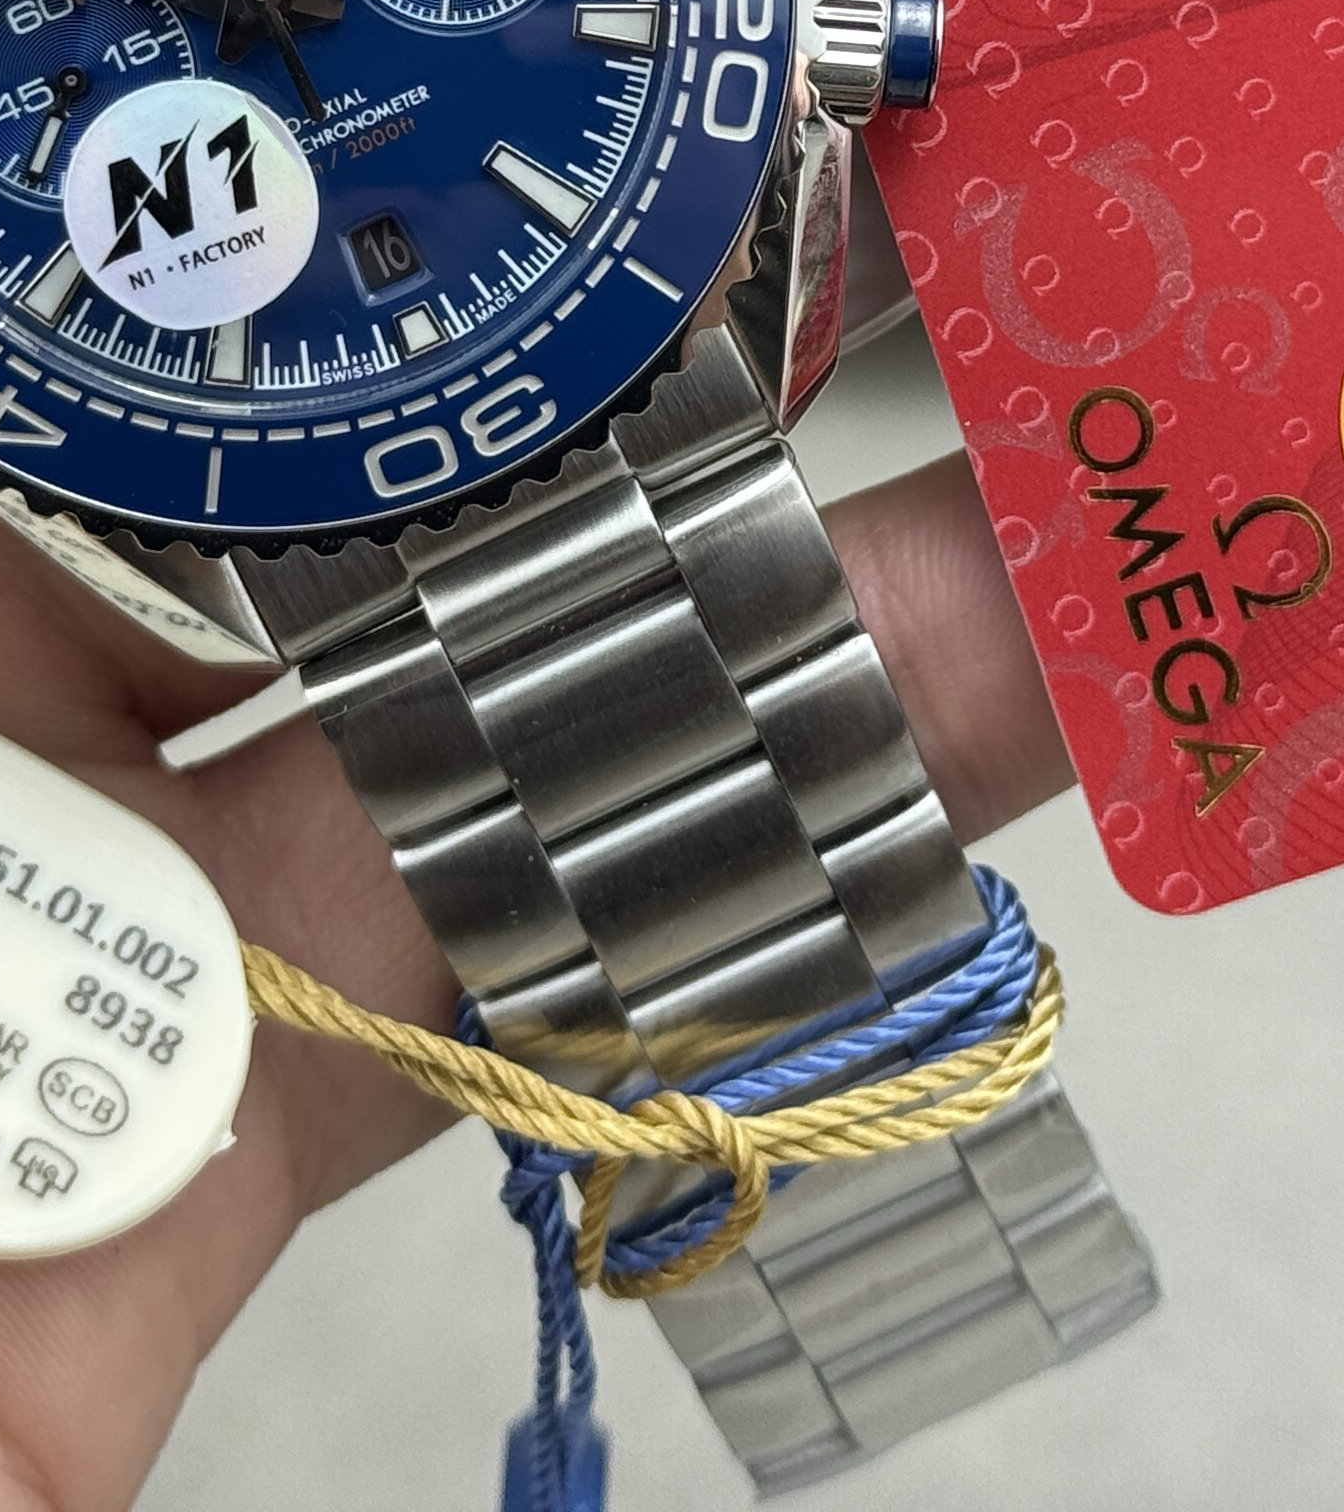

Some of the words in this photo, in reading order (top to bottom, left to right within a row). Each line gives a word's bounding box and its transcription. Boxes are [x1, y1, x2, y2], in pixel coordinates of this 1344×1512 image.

[102, 29, 161, 73] 15
[128, 267, 155, 291] N1
[178, 225, 267, 274] FACTORY
[363, 222, 411, 280] 16
[322, 362, 375, 386] SWISS
[474, 288, 518, 325] MADE
[360, 371, 558, 500] 30
[1068, 386, 1266, 818] OMEGA
[64, 973, 186, 1068] 8938
[47, 1070, 119, 1126] SCB
